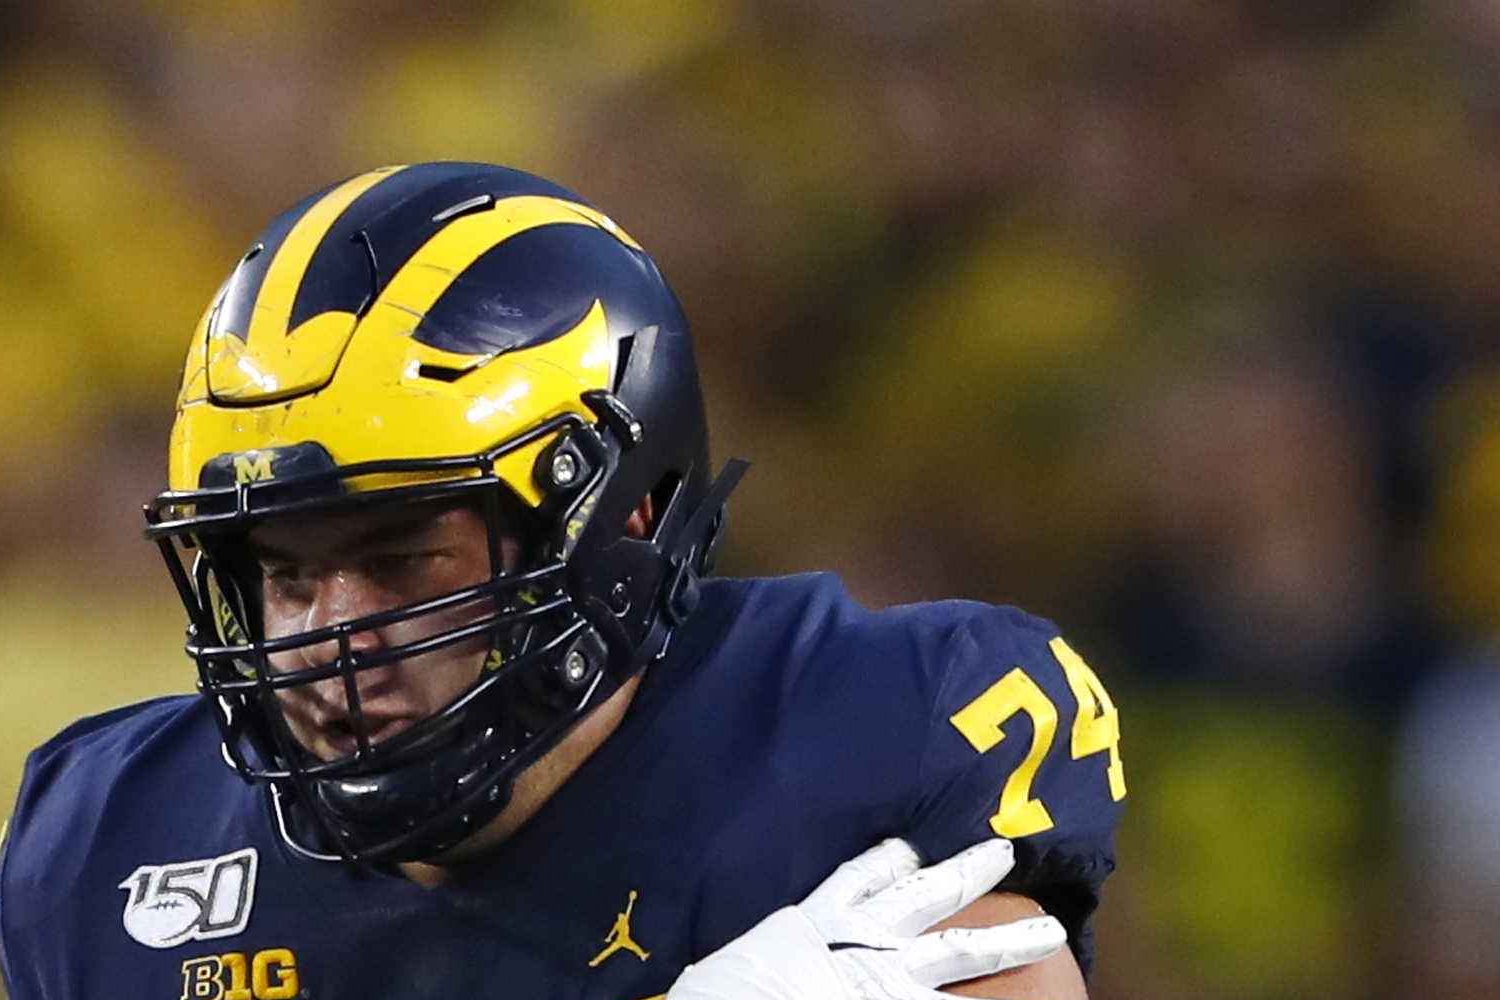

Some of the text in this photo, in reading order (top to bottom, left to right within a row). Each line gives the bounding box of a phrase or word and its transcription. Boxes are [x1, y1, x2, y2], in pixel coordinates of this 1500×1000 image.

[233, 449, 275, 484] M
[949, 636, 1127, 839] 74
[119, 848, 257, 947] 150
